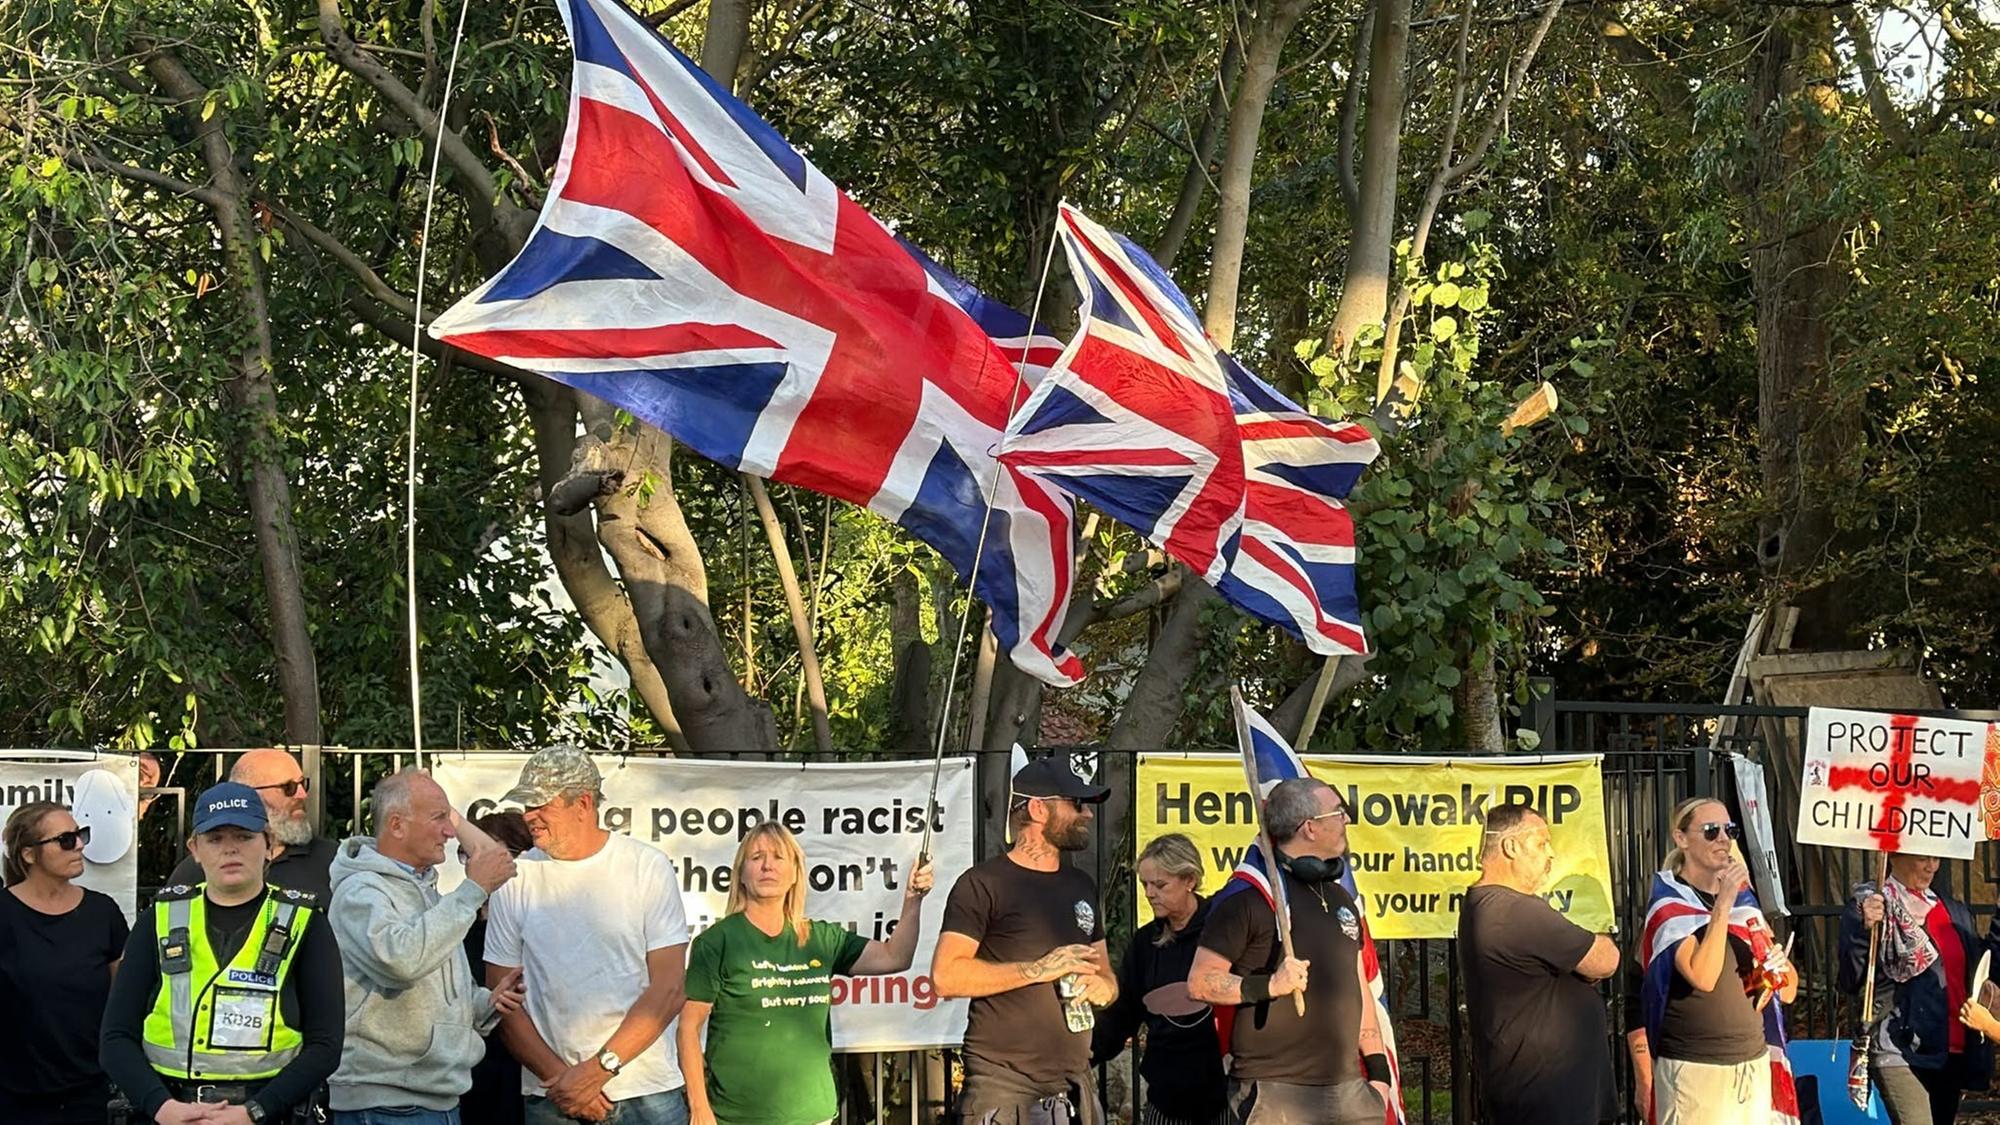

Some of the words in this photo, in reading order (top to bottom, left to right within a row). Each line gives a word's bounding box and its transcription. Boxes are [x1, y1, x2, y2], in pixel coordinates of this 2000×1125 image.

[1827, 721, 1973, 758] PROTECT
[1868, 762, 1934, 789] OUR
[208, 799, 248, 813] POLICE
[1155, 782, 1263, 825] Hen
[1329, 783, 1490, 827] Nowak
[1504, 784, 1582, 825] RIP
[650, 799, 807, 842] people
[822, 798, 945, 835] racist
[1811, 799, 1972, 839] CHILDREN
[808, 856, 899, 893] on't
[1345, 852, 1395, 872] our
[1374, 892, 1441, 918] your
[230, 970, 275, 986] POLICE
[761, 996, 782, 1008] But
[782, 996, 807, 1008] very
